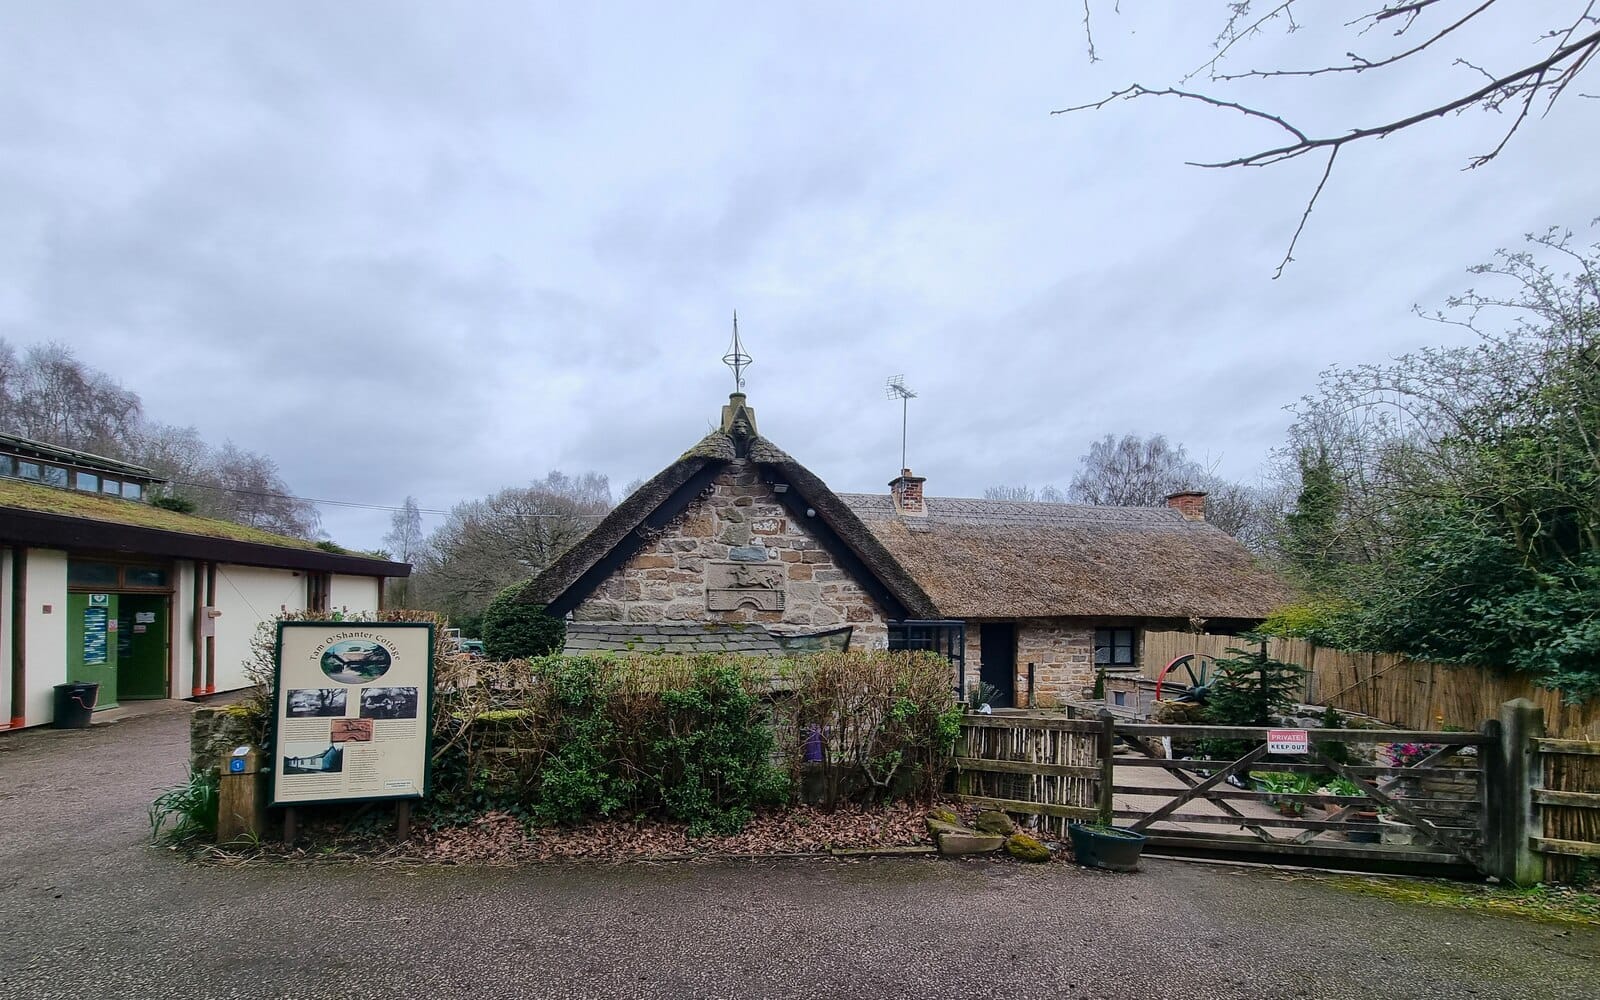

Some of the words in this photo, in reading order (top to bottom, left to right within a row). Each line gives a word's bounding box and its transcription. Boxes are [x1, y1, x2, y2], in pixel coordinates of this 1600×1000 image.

[309, 644, 325, 661] Tam
[326, 631, 373, 643] O'Shanter
[375, 634, 401, 661] Cottage
